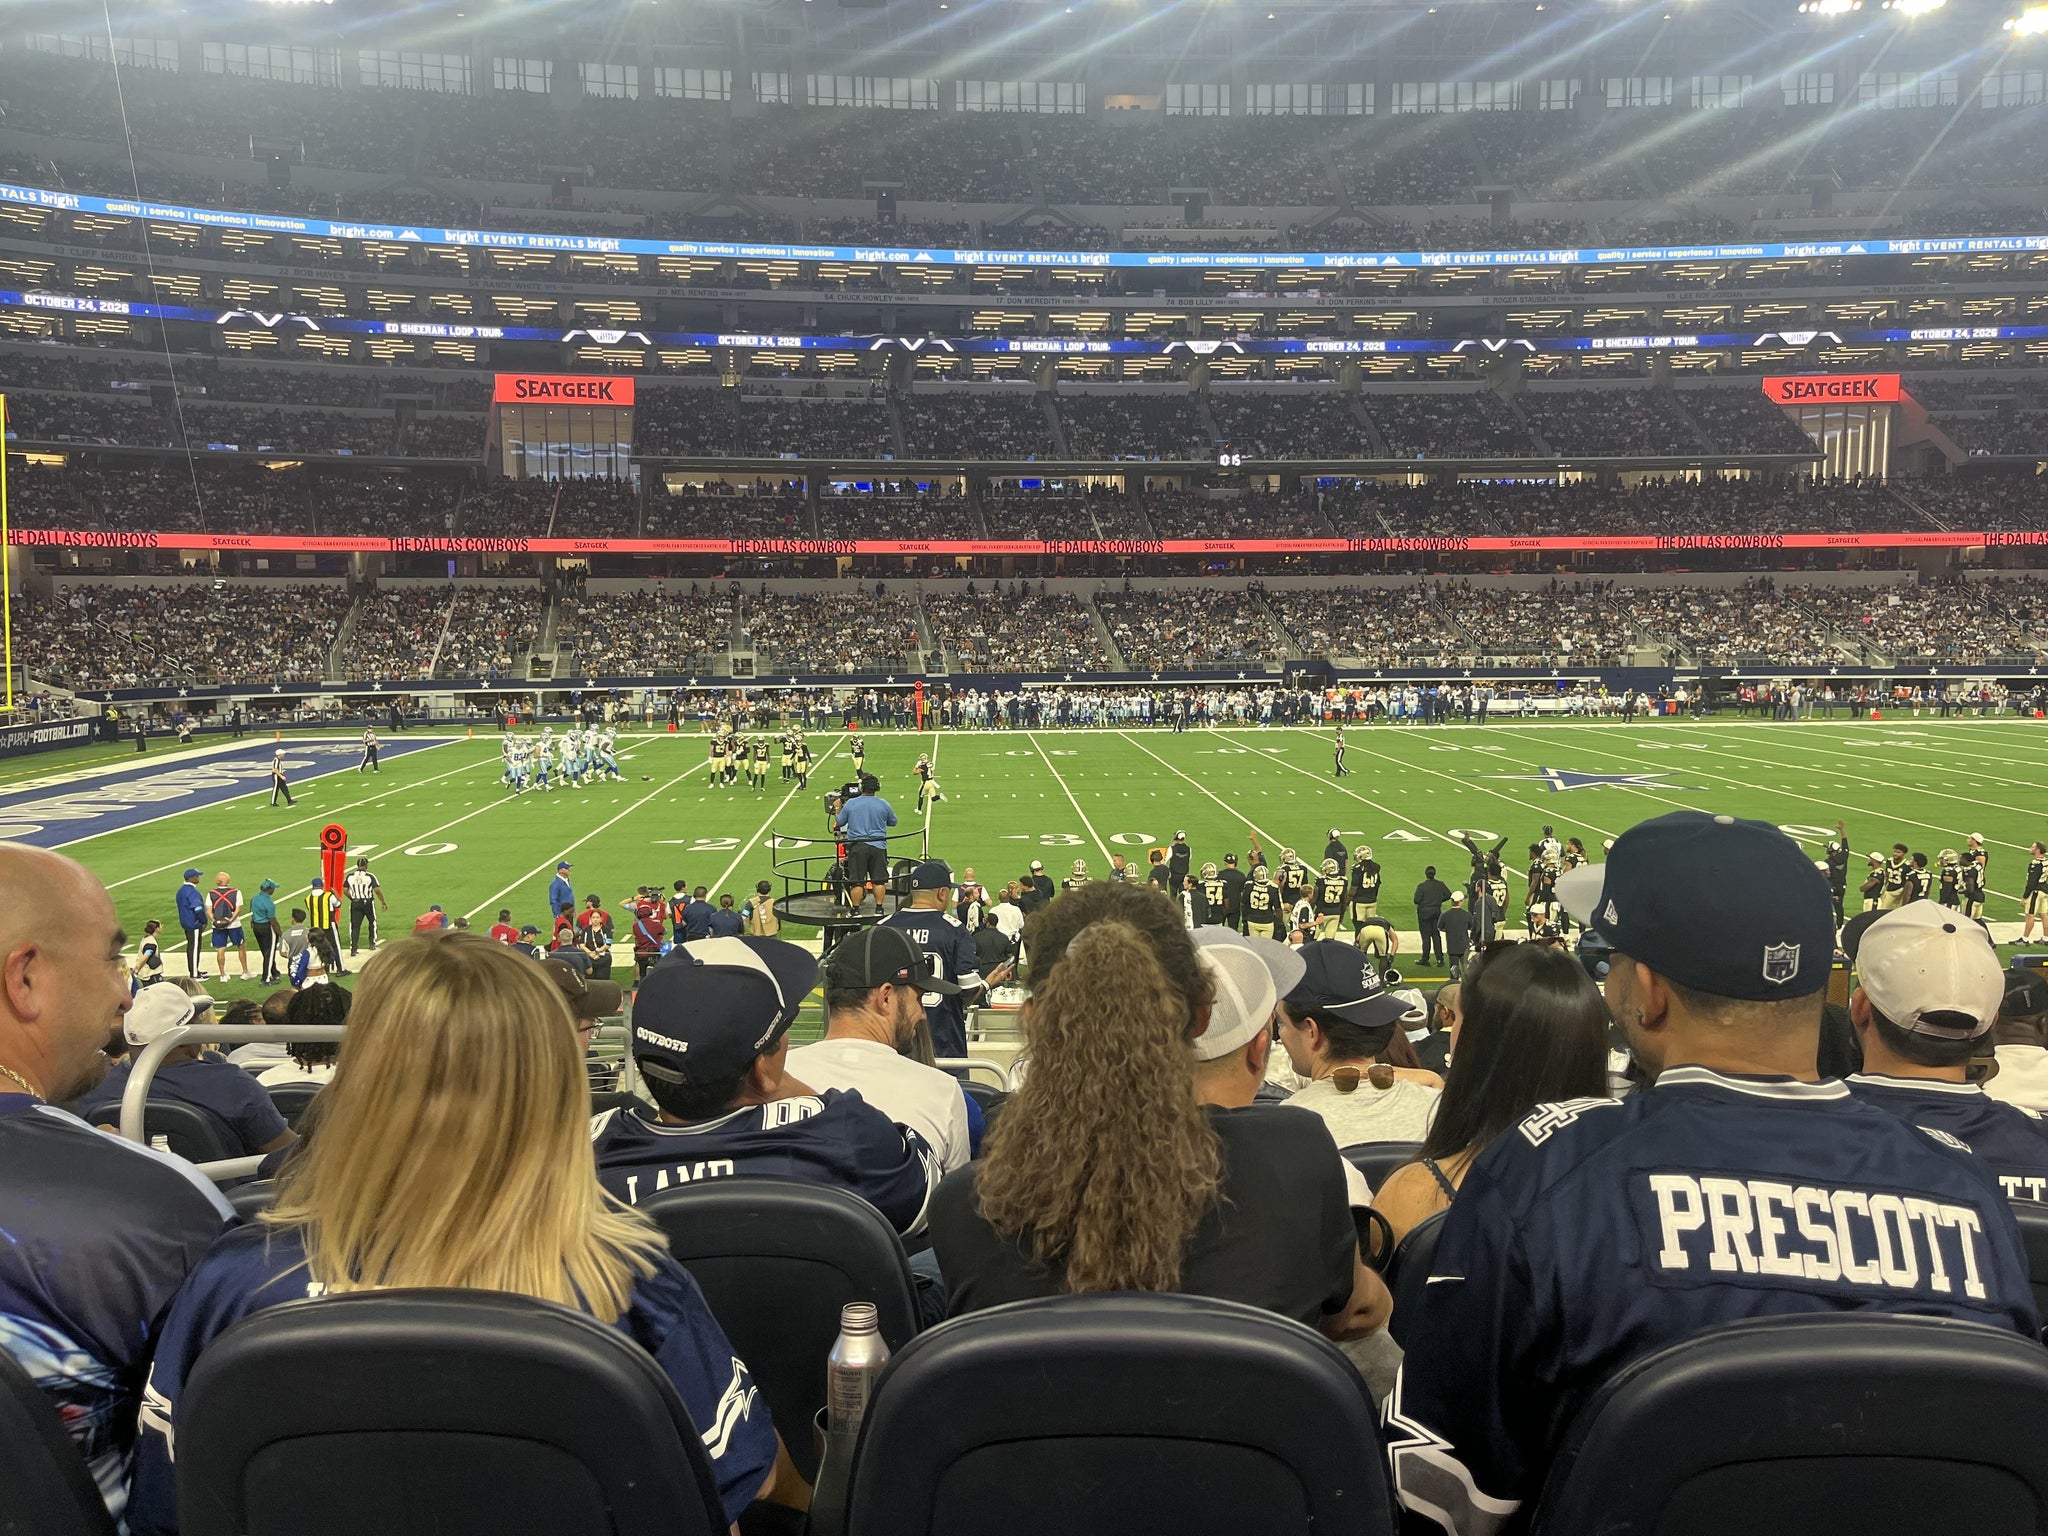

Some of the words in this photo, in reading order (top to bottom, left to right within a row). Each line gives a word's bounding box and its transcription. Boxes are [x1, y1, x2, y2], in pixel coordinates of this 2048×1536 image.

[41, 191, 79, 208] bright
[106, 203, 140, 214] quality
[150, 208, 185, 218] service
[194, 212, 247, 225] experience
[256, 218, 305, 230] innovation
[330, 225, 393, 239] bright.com
[445, 230, 479, 245] bright
[484, 234, 524, 246] EVENT
[529, 237, 584, 249] RENTALS
[587, 238, 619, 252] bright
[1889, 241, 1920, 253] bright
[1924, 241, 1963, 251] EVENT
[1968, 239, 2022, 249] RENTALS
[669, 244, 697, 254] quality
[704, 245, 734, 254] service
[741, 247, 785, 257] experience
[792, 248, 834, 257] innovation
[855, 249, 909, 262] bright.com
[1598, 251, 1626, 260] quality
[1632, 250, 1662, 259] service
[1668, 249, 1713, 258] experience
[1720, 247, 1763, 256] innovation
[1784, 245, 1841, 257] bright.com
[954, 250, 984, 264] bright
[987, 254, 1024, 263] EVENT
[1028, 254, 1078, 264] RENTALS
[1081, 254, 1110, 266] bright
[1148, 256, 1175, 265] quality
[1181, 256, 1209, 264] service
[1215, 256, 1258, 264] experience
[1264, 256, 1304, 264] innovation
[1325, 255, 1377, 266] bright.com
[1422, 254, 1451, 266] bright
[1454, 254, 1491, 263] EVENT
[1495, 253, 1546, 262] RENTALS
[1549, 251, 1579, 264] bright
[316, 270, 345, 280] HAYES
[515, 282, 542, 291] WHITE
[1712, 291, 1742, 299] JORDAN
[24, 294, 75, 309] OCTOBER
[78, 299, 97, 312] 24,
[99, 301, 129, 313] 2026
[386, 324, 399, 333] ED
[401, 325, 446, 336] SHEERAN:
[450, 326, 474, 336] LOOP
[1911, 330, 1953, 340] OCTOBER
[1955, 329, 1970, 339] 24,
[1973, 328, 1998, 338] 2026
[718, 335, 758, 346] OCTOBER
[761, 337, 775, 347] 24,
[778, 337, 801, 347] 2026
[1010, 342, 1020, 351] ED
[1022, 343, 1062, 351] SHEERAN:
[1064, 343, 1086, 351] LOOP
[1307, 342, 1344, 351] OCTOBER
[1347, 342, 1361, 352] 24,
[1363, 342, 1385, 351] 2026
[1592, 339, 1603, 348] ED
[1606, 338, 1647, 348] SHEERAN:
[1649, 337, 1671, 347] LOOP
[516, 379, 614, 401] SEATGEEK
[1782, 379, 1879, 400] SEATGEEK
[0, 530, 24, 545] HE
[28, 530, 81, 546] DALLAS
[85, 532, 158, 548] COWBOYS
[212, 538, 251, 546] SEATGEEK
[388, 538, 411, 552] THE
[415, 538, 462, 552] DALLAS
[466, 539, 528, 553] COWBOYS
[1347, 539, 1366, 551] THE
[1369, 539, 1410, 551] DALLAS
[1413, 538, 1468, 550] COWBOYS
[1510, 540, 1541, 548] SEATGEEK
[1656, 537, 1675, 549] THE
[1678, 536, 1722, 548] DALLAS
[1724, 535, 1783, 548] COWBOYS
[1982, 533, 2004, 545] THE
[575, 542, 608, 550] SEATGEEK
[729, 541, 751, 553] THE
[753, 541, 797, 553] DALLAS
[800, 541, 857, 553] COWBOYS
[1043, 541, 1062, 553] THE
[1065, 541, 1106, 553] DALLAS
[1109, 541, 1164, 553] COWBOYS
[33, 723, 89, 744] FOOTBALL.COM
[1039, 833, 1157, 846] 30
[1382, 829, 1500, 841] 40
[1288, 870, 1304, 888] 57
[1919, 879, 1928, 897] 7
[1205, 887, 1223, 905] 54
[1250, 891, 1270, 910] 62
[1324, 886, 1344, 904] 67
[637, 1026, 689, 1053] COWBOYS
[1649, 1174, 1986, 1299] PRESCOTT
